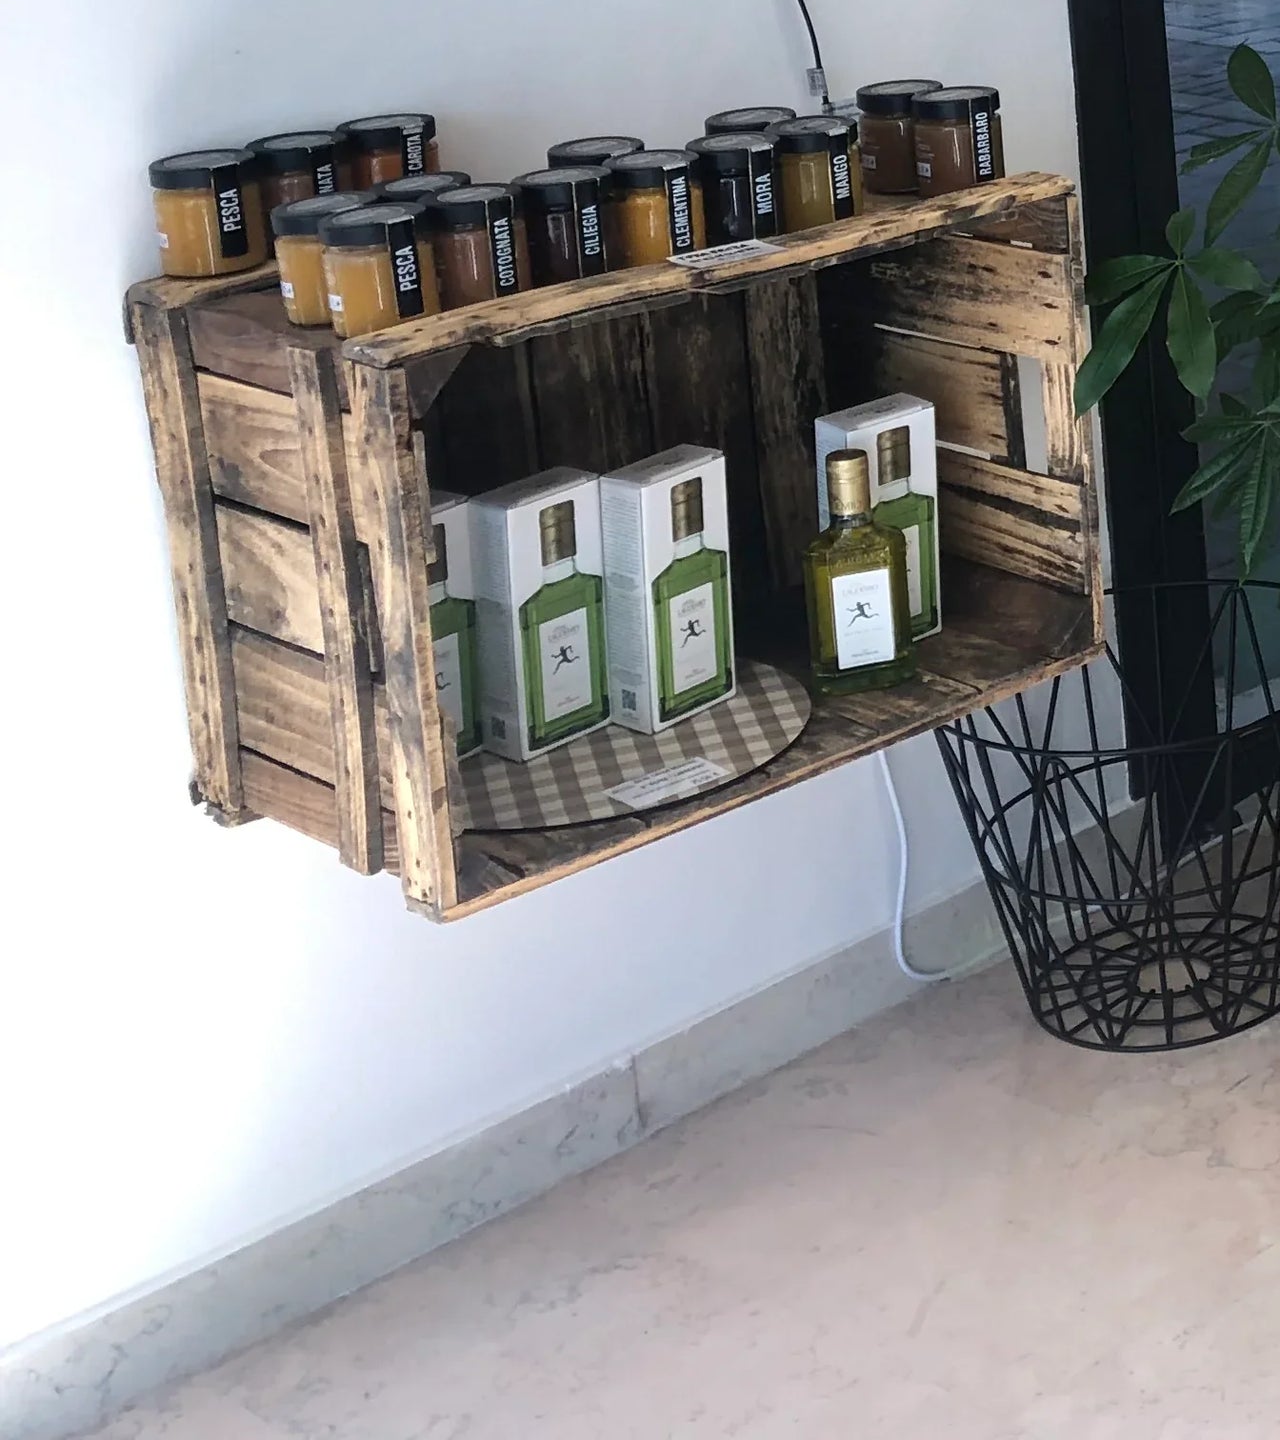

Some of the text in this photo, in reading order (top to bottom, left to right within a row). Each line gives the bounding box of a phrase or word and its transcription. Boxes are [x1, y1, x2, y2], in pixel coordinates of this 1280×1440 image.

[974, 111, 993, 176] RABARBARO
[756, 172, 773, 216] MORA
[833, 154, 851, 200] MANGO
[219, 188, 242, 233] PESCA
[581, 204, 602, 256] CILIEGIA
[671, 175, 691, 249] CLEMENTINA
[395, 245, 418, 293] PESCA
[493, 216, 516, 287] COTOGNATA
